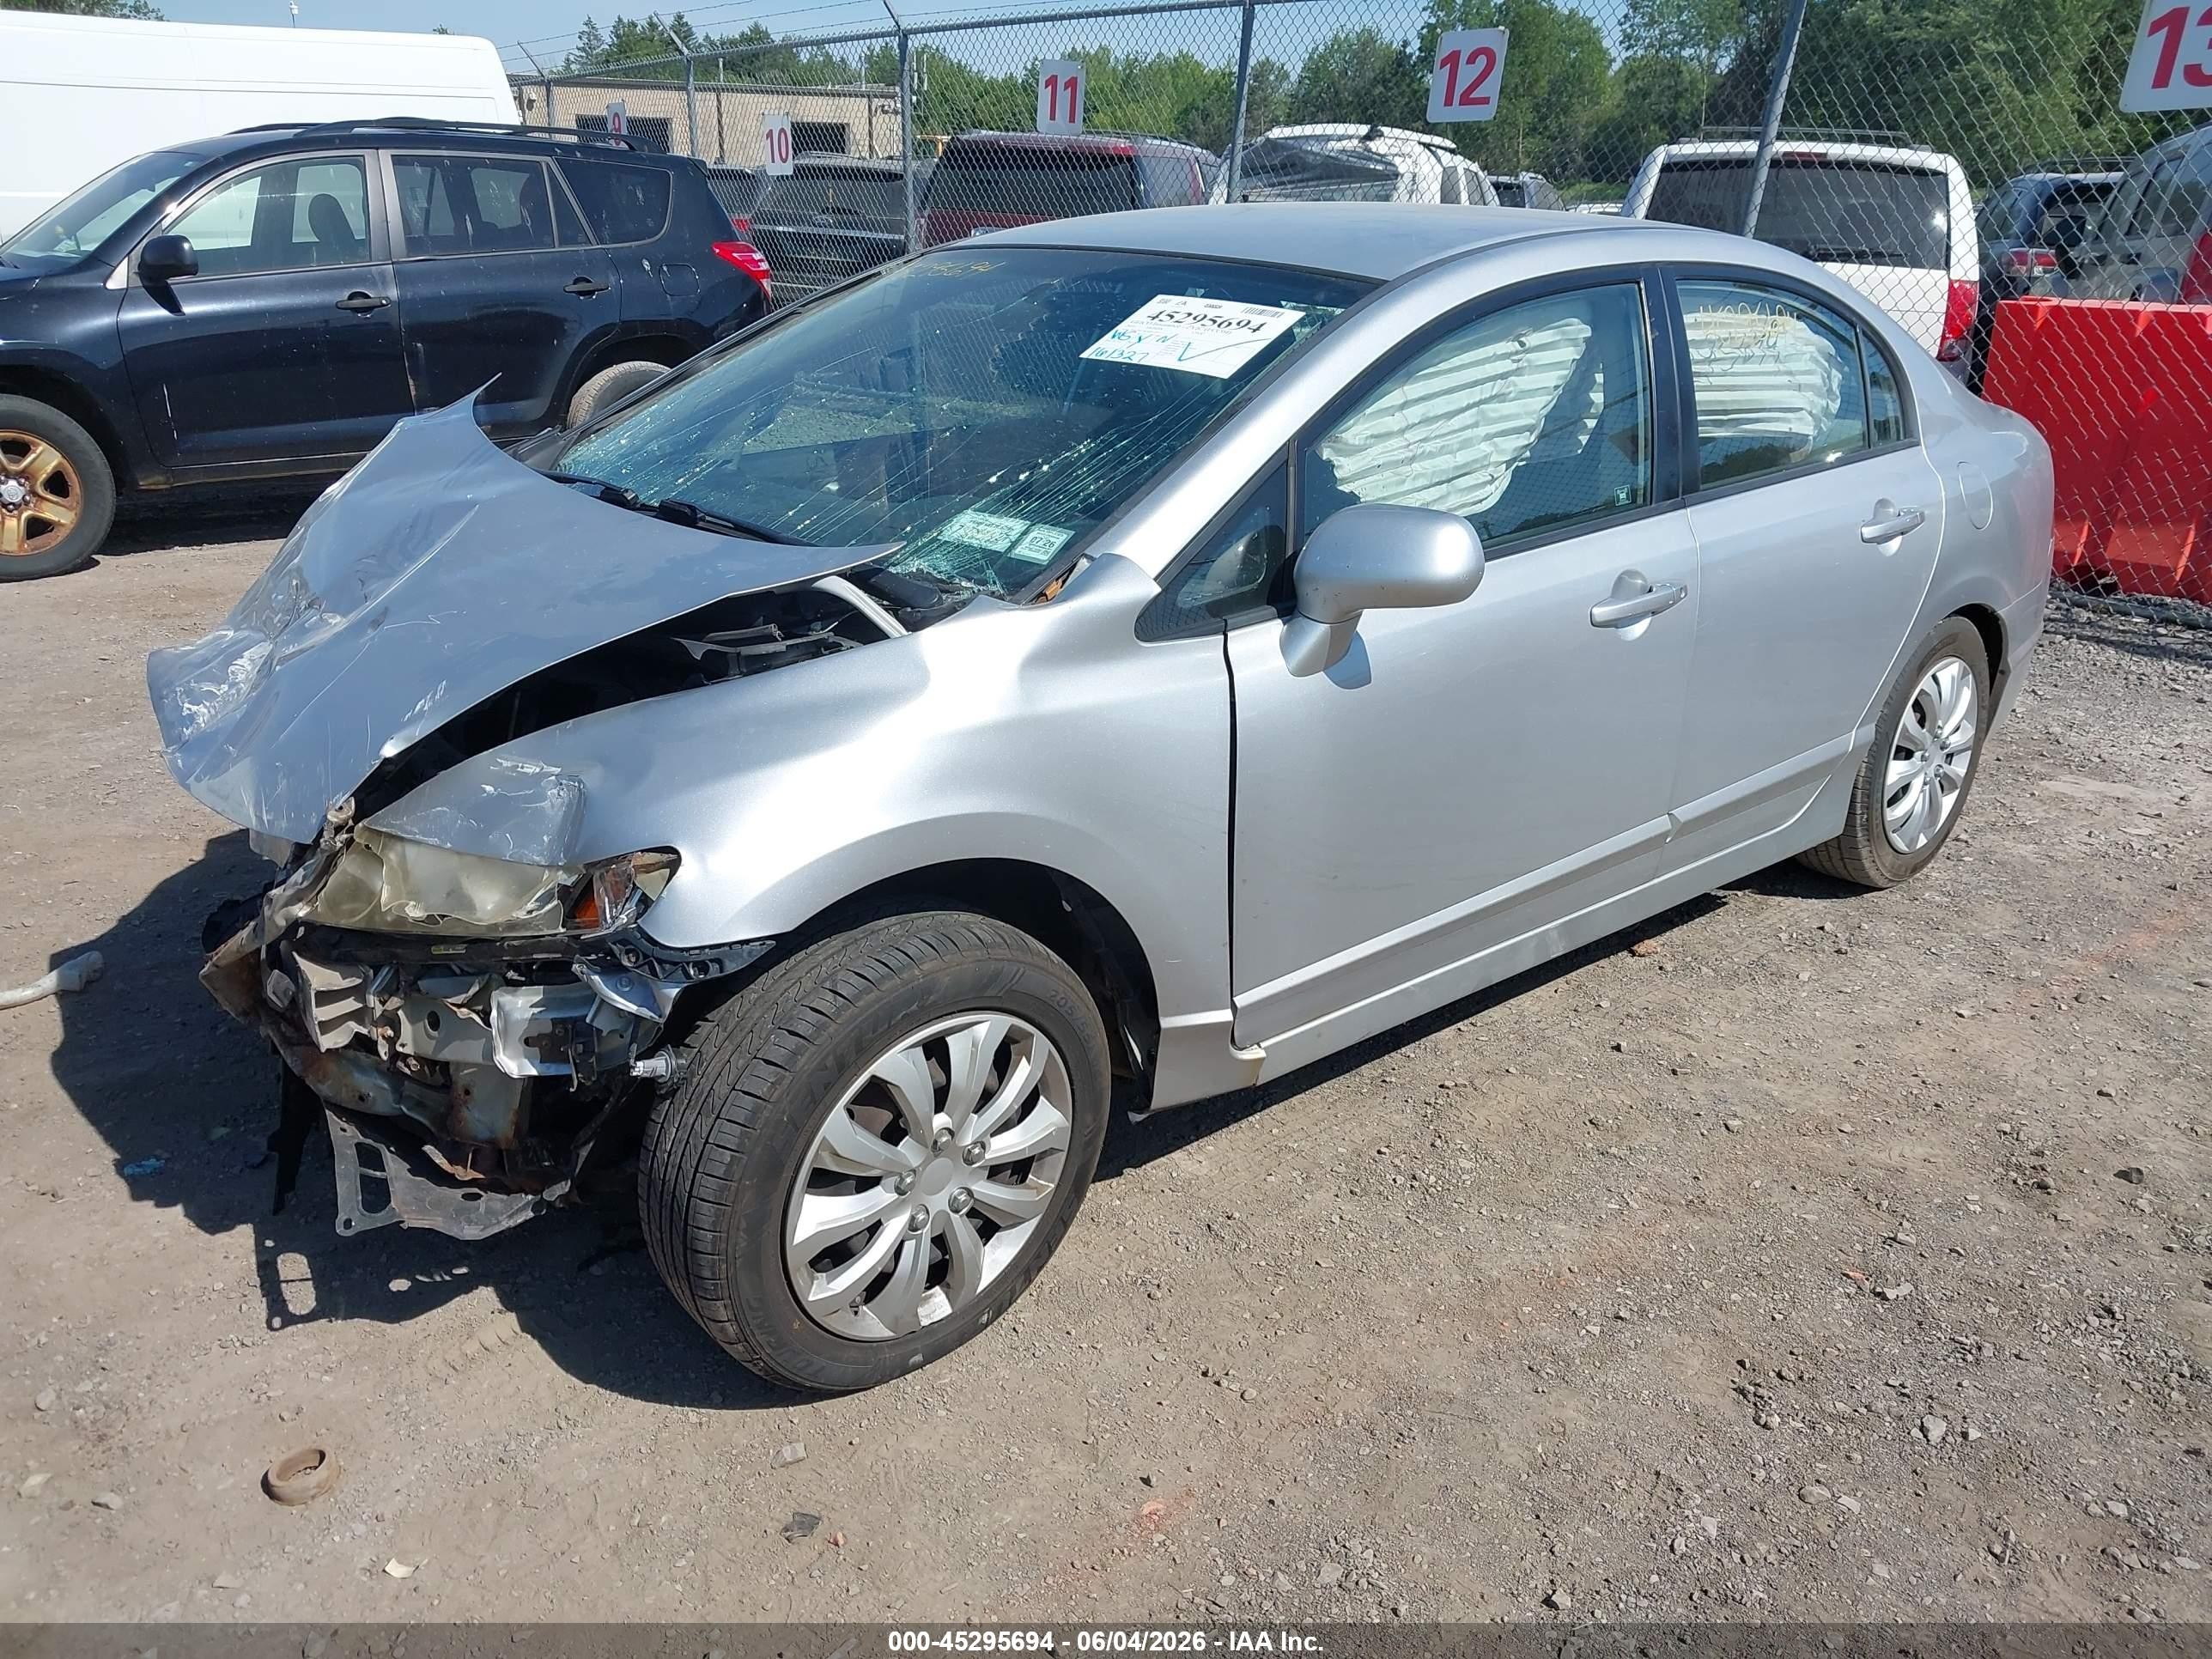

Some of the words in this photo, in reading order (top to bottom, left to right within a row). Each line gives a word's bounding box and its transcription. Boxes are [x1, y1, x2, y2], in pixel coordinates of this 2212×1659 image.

[1439, 46, 1497, 107] 12
[1044, 74, 1078, 124] 11
[766, 127, 789, 163] 10
[1146, 309, 1267, 334] 45295694
